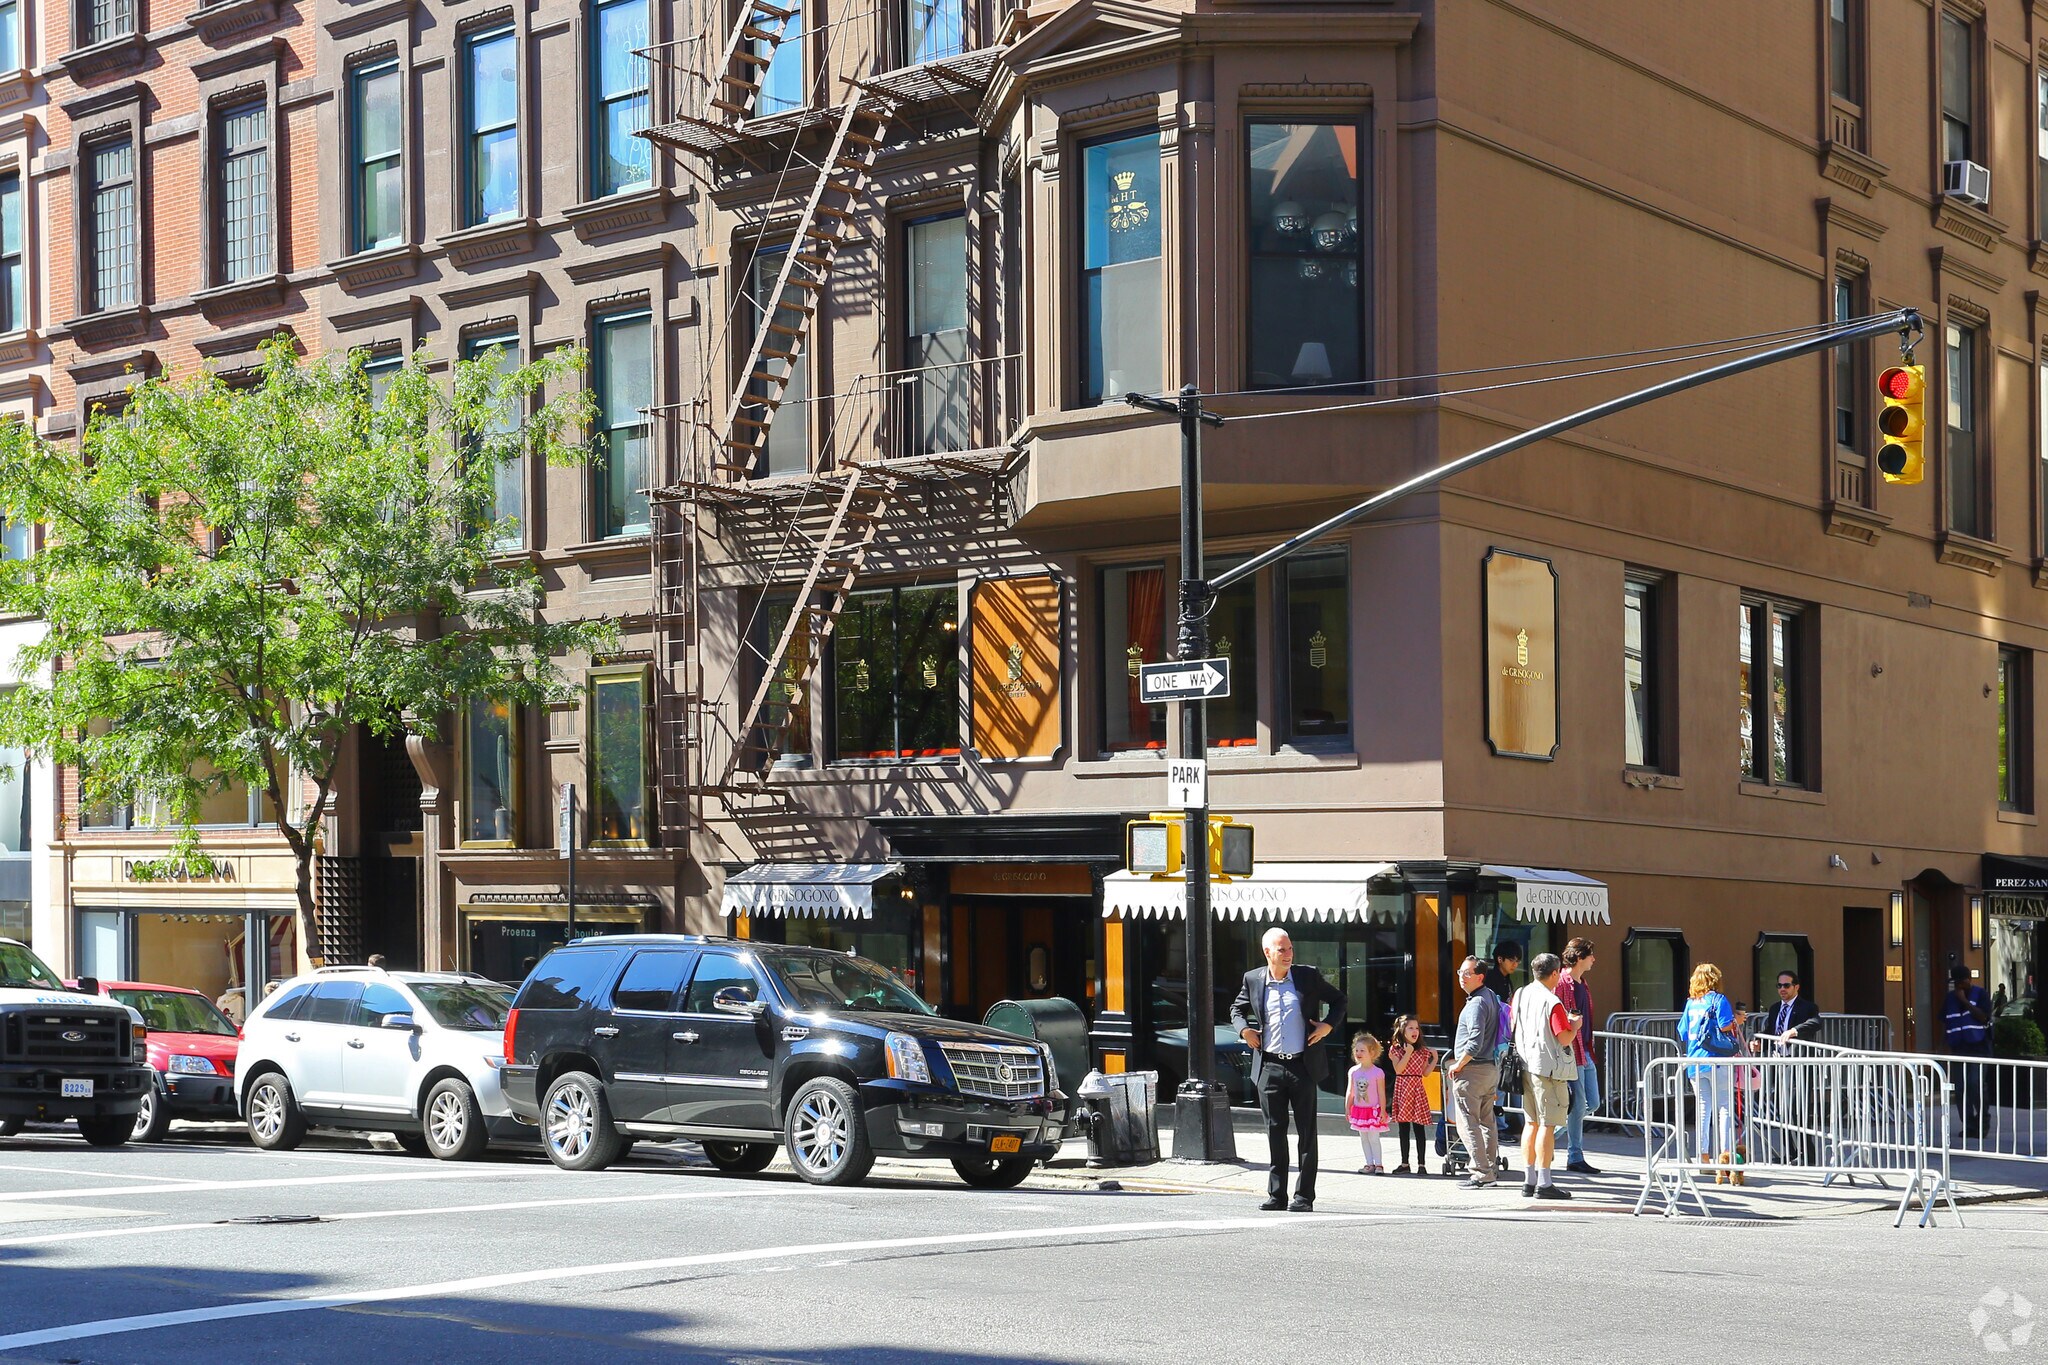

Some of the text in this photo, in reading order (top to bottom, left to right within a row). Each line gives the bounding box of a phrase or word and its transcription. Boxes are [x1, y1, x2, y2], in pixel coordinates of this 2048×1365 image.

[1154, 671, 1215, 690] ONE WAY
[1172, 766, 1200, 784] PARK
[1995, 878, 2027, 887] PEREZ
[768, 888, 840, 903] GRISOGONO
[1526, 888, 1601, 907] de GRISOGONO
[1994, 897, 2026, 916] PEREZ
[501, 926, 604, 938] Proenza Shouler
[36, 995, 93, 1005] POLICE
[64, 1083, 85, 1093] 8229
